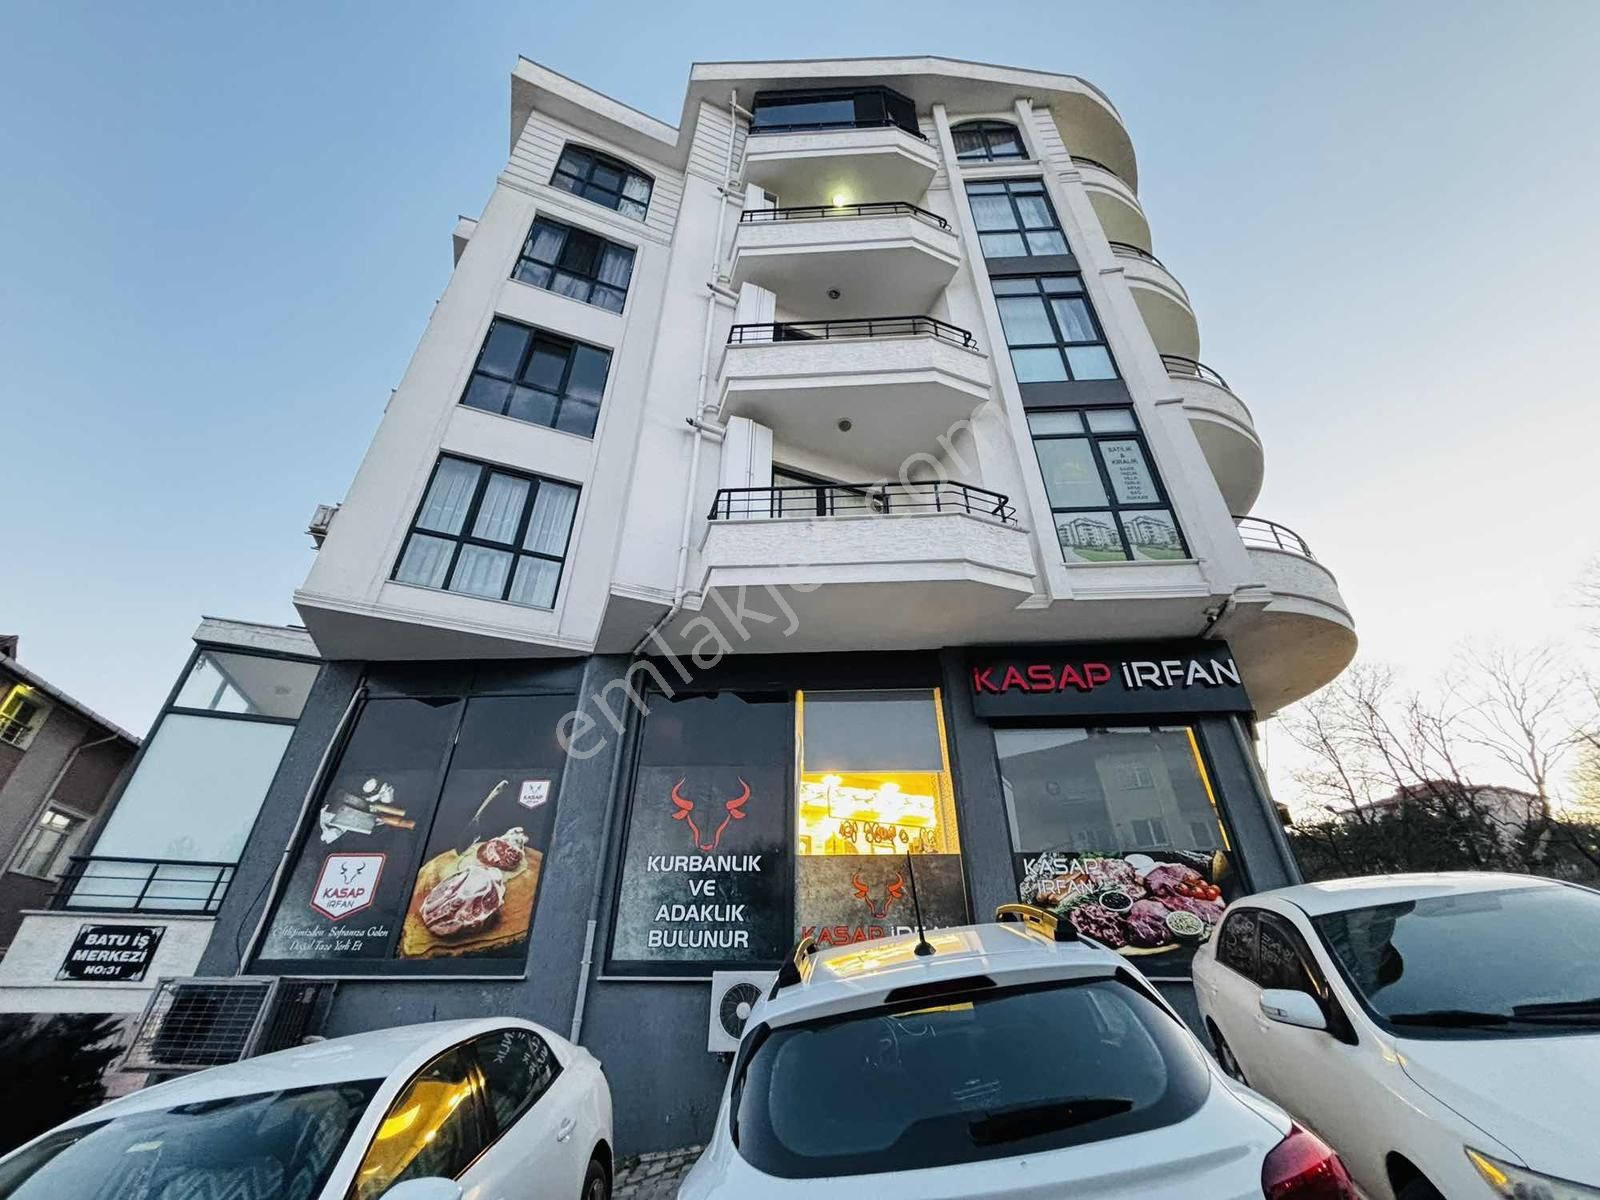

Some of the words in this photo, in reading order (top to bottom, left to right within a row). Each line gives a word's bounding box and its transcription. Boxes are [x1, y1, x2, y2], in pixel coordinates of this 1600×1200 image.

[973, 663, 1111, 693] KASAP
[647, 854, 762, 873] KURBANLIK
[1023, 857, 1098, 876] KASAP
[322, 887, 366, 899] KASAP
[689, 879, 716, 897] VE
[654, 904, 747, 922] ADAKLIK
[84, 934, 131, 946] BATU
[131, 932, 150, 949] İŞ
[647, 930, 749, 949] BULUNUR
[801, 925, 884, 947] KASAP
[72, 948, 148, 963] MERKEZİ
[83, 965, 122, 975] NO:31
